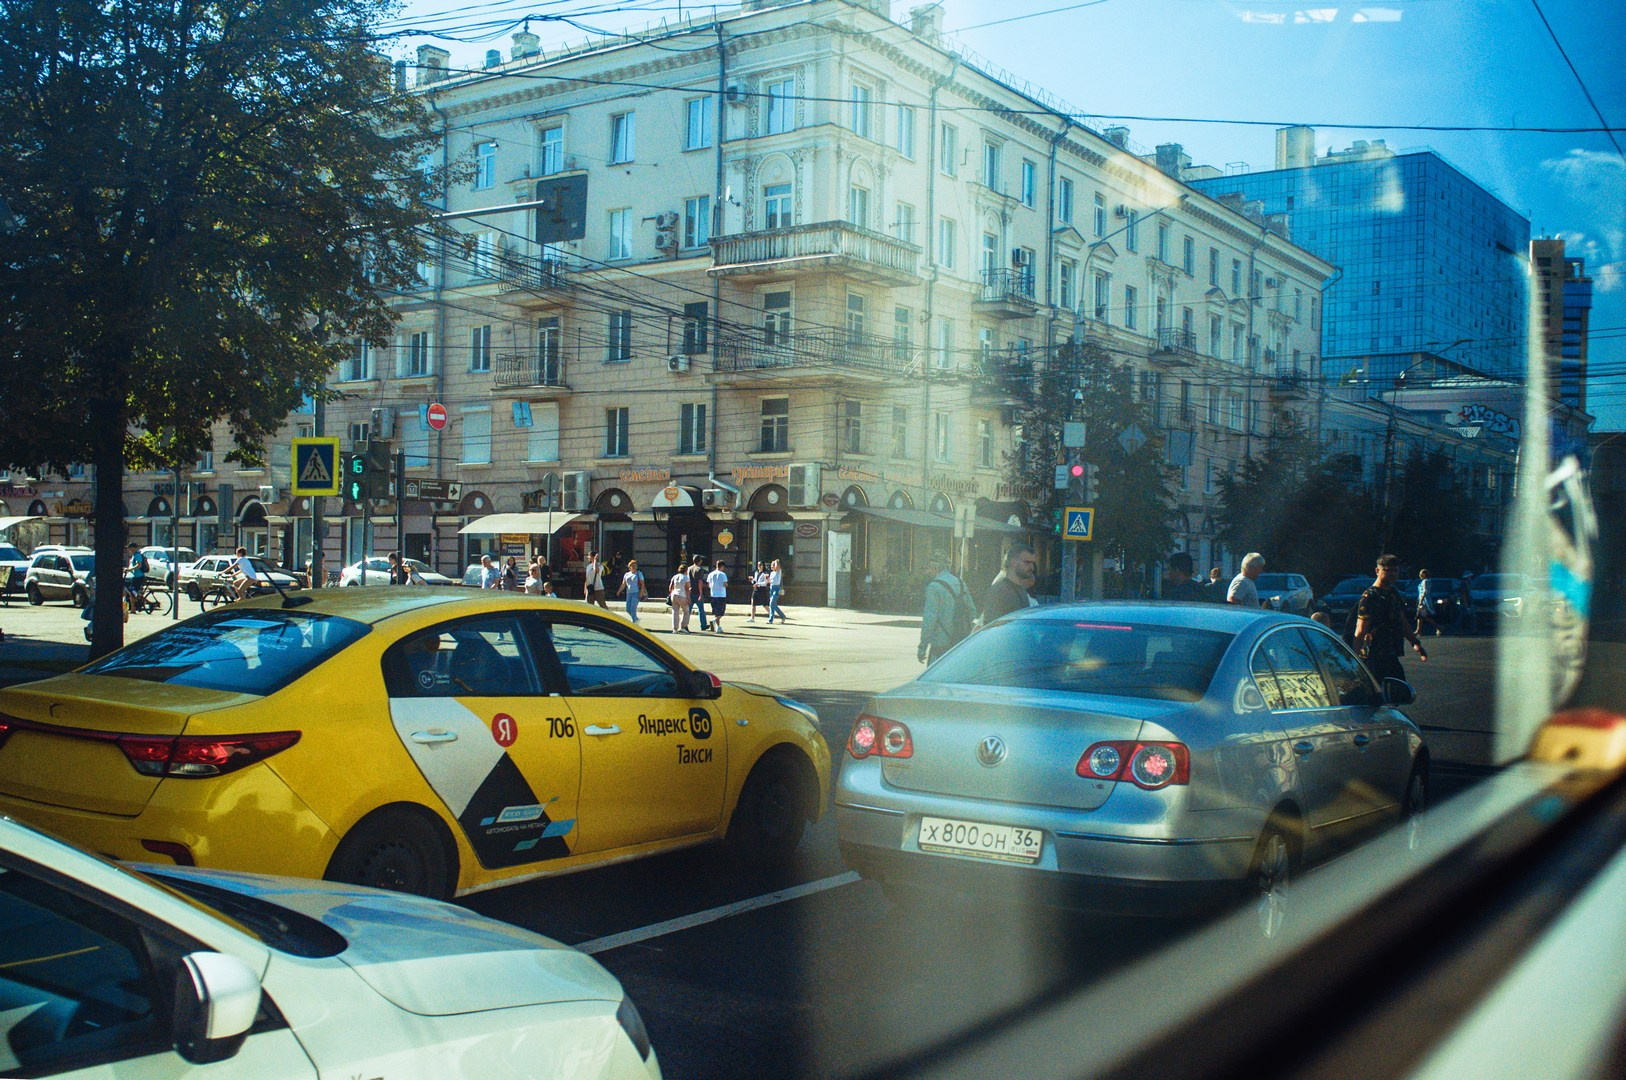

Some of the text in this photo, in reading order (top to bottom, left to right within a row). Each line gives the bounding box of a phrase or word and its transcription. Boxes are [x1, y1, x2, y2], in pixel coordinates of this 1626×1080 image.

[353, 459, 363, 474] 16
[498, 718, 511, 741] Я
[545, 716, 575, 738] 706
[638, 713, 710, 737] Яндекс Go
[676, 744, 713, 765] Такси
[1013, 829, 1034, 847] 36
[1010, 846, 1026, 854] RUS
